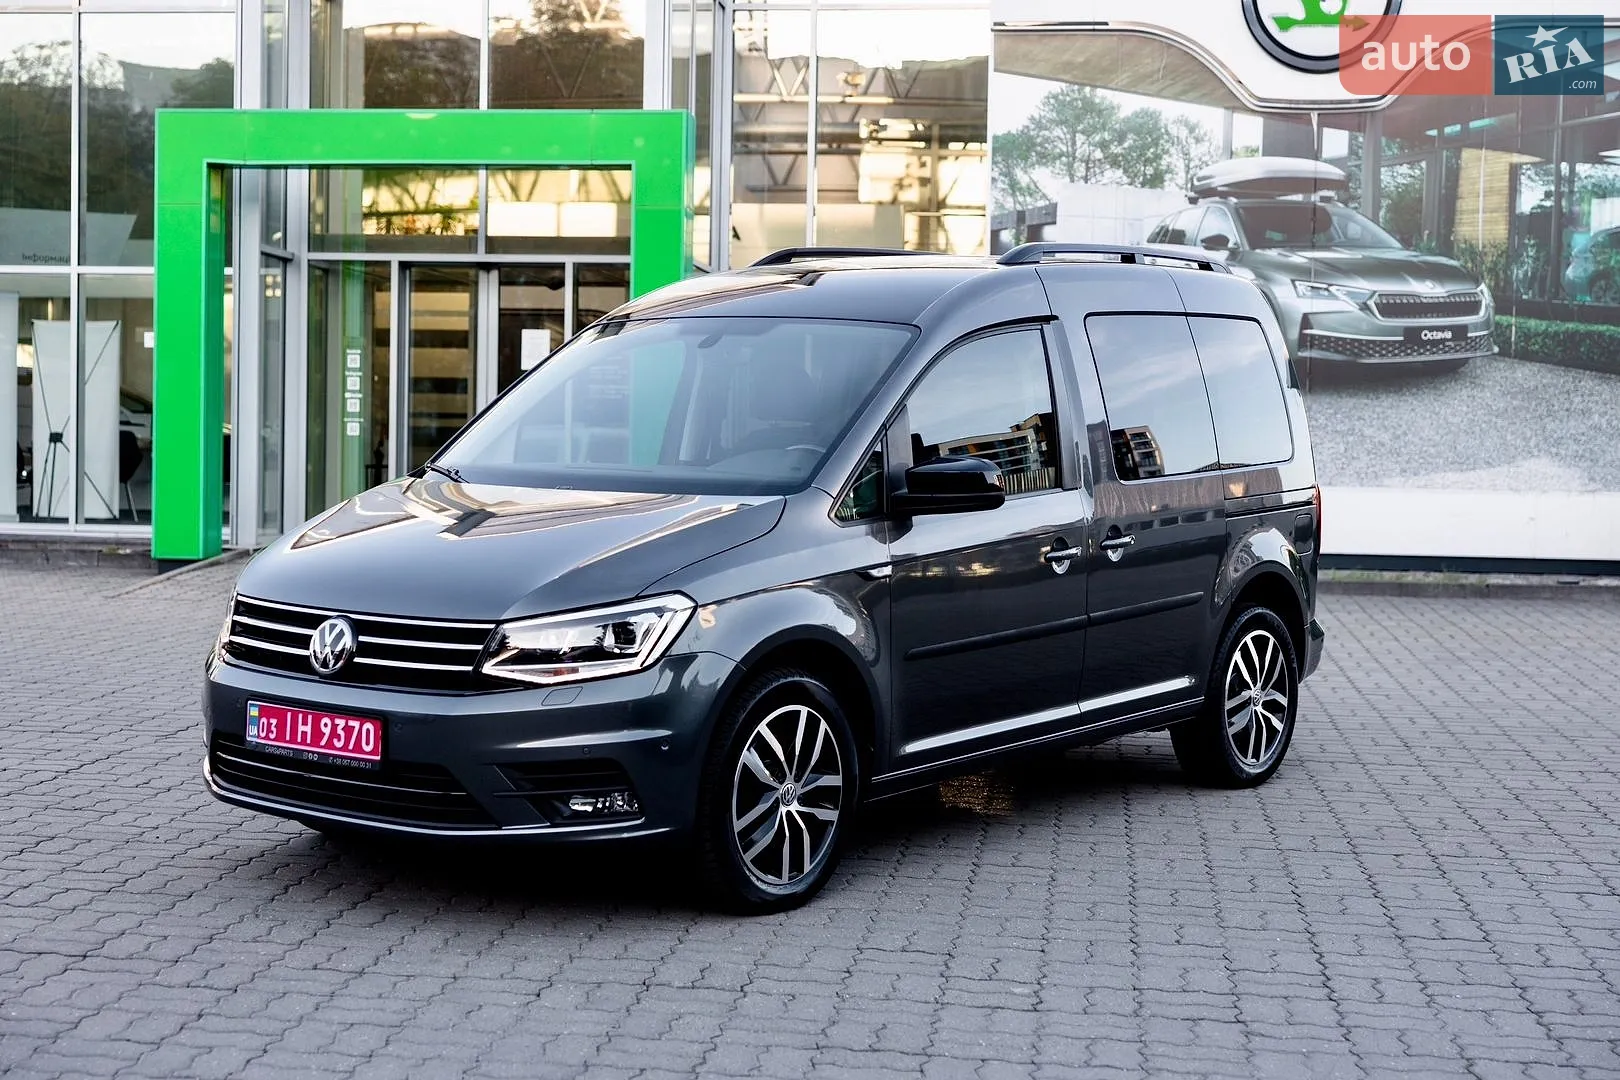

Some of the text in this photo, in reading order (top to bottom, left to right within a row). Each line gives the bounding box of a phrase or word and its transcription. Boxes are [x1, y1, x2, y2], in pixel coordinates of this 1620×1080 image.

[1421, 330, 1452, 340] Octavia
[249, 725, 258, 736] UA
[259, 717, 277, 739] 03
[320, 717, 375, 752] 9370
